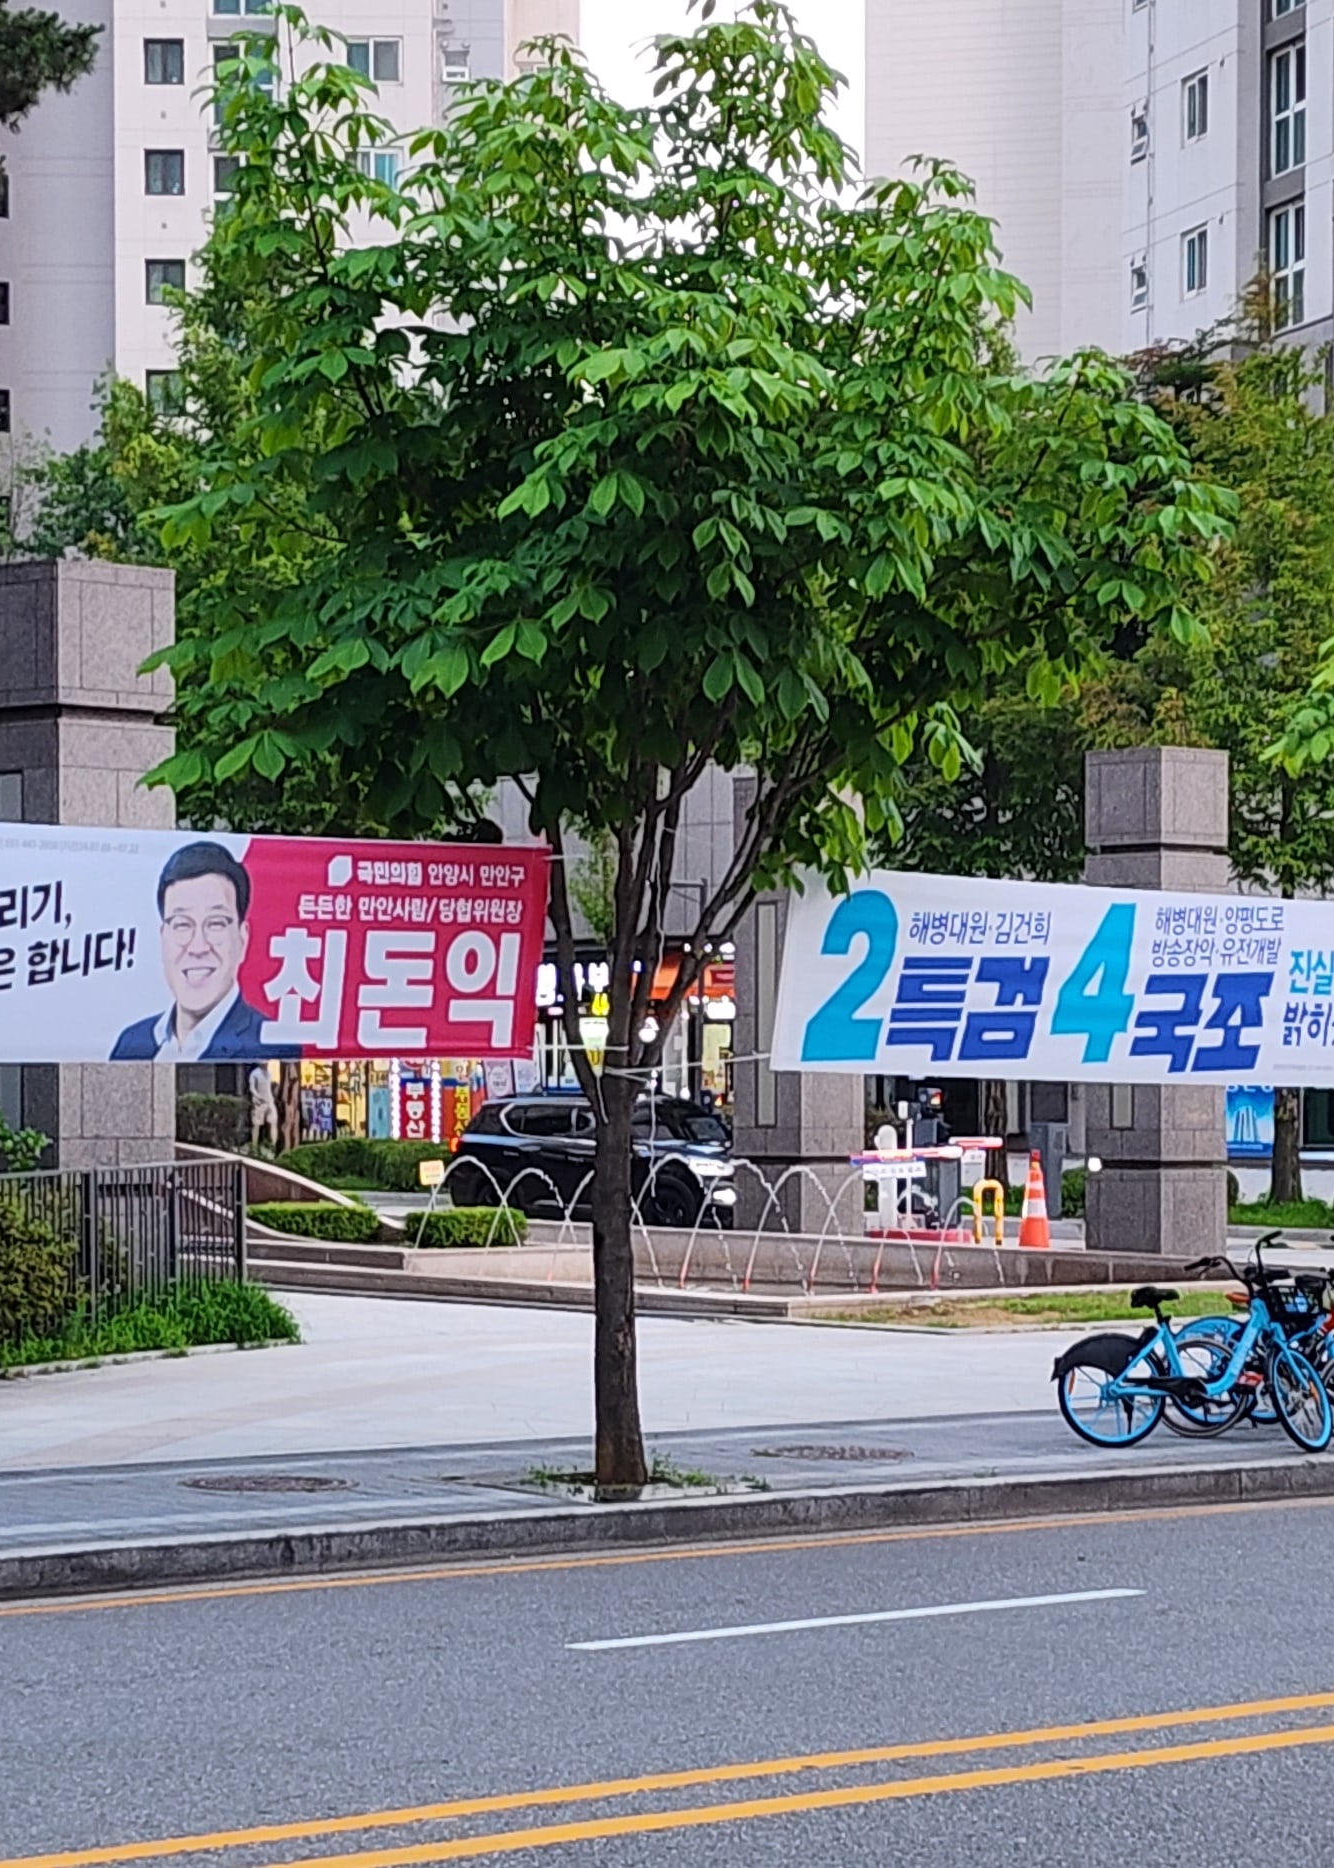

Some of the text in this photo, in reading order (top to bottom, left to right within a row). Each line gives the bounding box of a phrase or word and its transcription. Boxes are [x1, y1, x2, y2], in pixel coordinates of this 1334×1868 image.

[357, 860, 525, 888] 국민의힘 안양시 만안구
[298, 894, 352, 921] 든든한
[26, 928, 136, 986] 합니다!
[800, 889, 1274, 1073] 2 특검 4 국조
[261, 927, 522, 1052] 최돈익
[405, 1081, 426, 1138] 부동산
